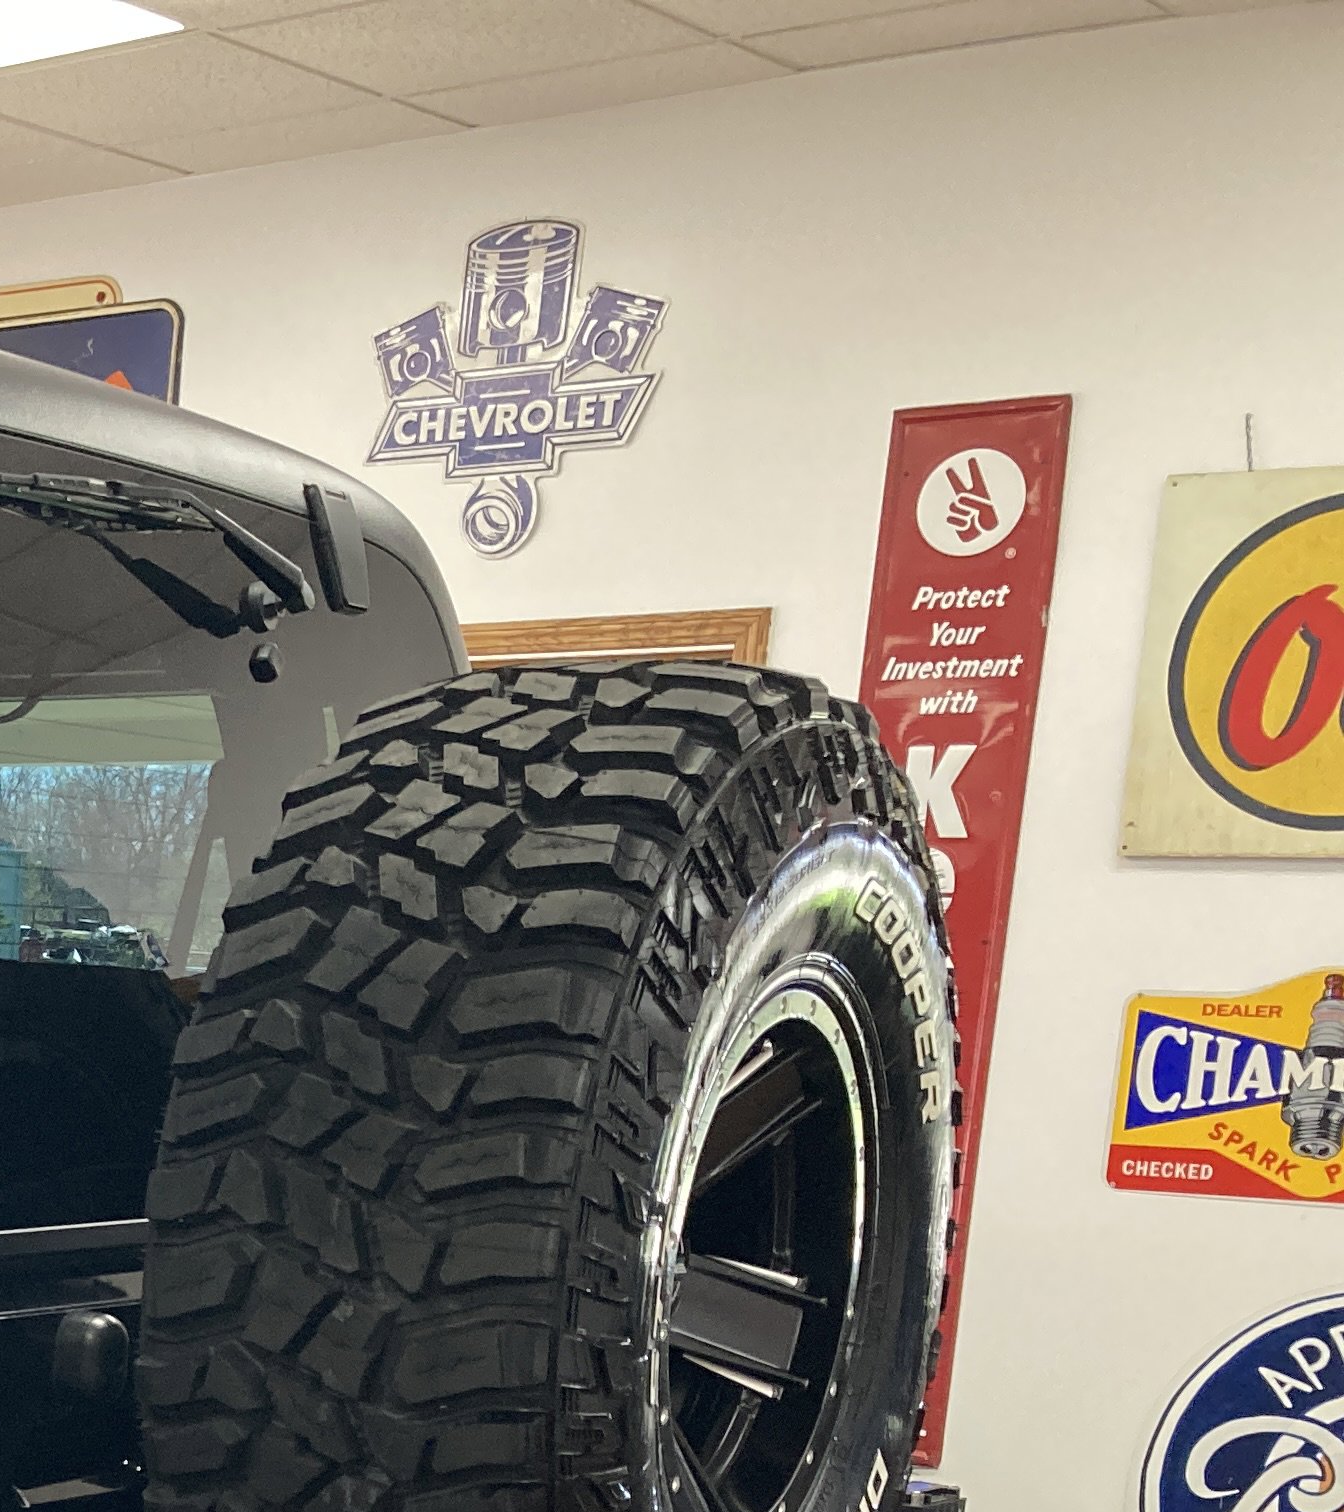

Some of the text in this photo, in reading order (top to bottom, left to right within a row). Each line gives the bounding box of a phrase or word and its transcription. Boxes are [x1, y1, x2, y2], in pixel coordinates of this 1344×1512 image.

[393, 393, 622, 446] CHEVROLET
[912, 584, 1012, 611] Protect
[928, 621, 986, 647] Your
[881, 654, 1024, 682] Investment
[918, 690, 979, 716] with
[854, 876, 939, 1126] COOPER
[1201, 1003, 1283, 1018] DEALER
[1208, 1121, 1301, 1183] SPARK
[1121, 1159, 1214, 1181] CHECKED
